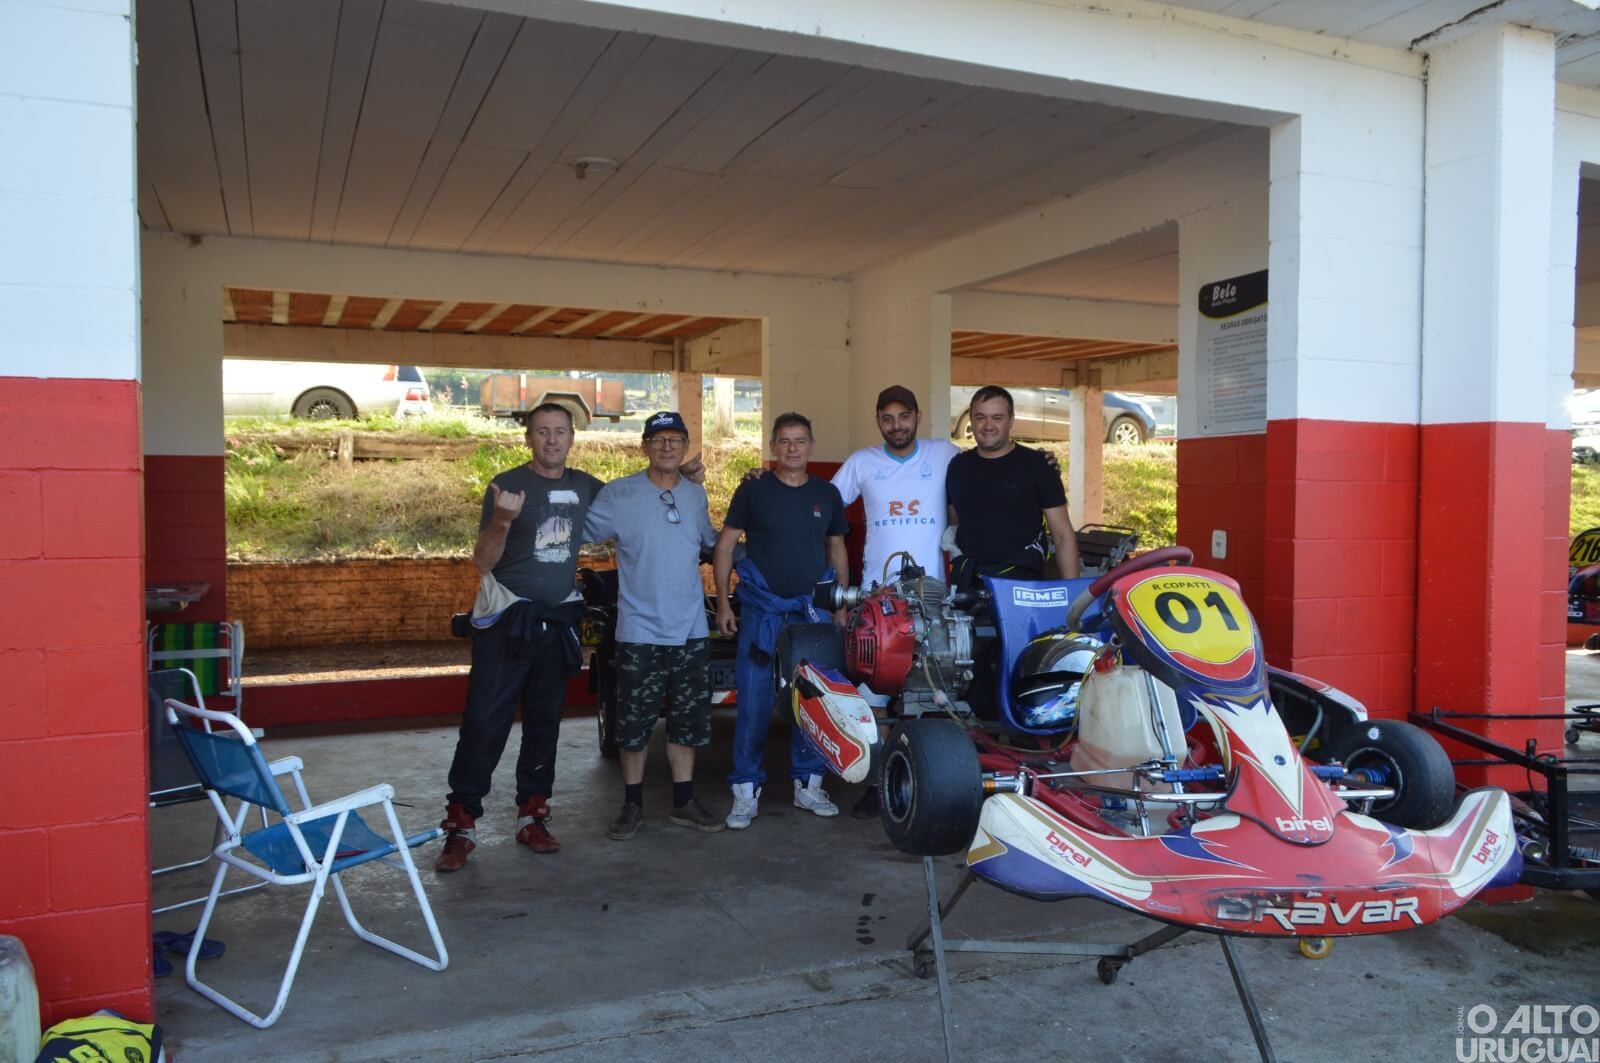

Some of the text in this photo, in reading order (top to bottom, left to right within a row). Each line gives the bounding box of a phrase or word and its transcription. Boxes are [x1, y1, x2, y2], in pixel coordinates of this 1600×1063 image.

[1212, 283, 1237, 301] Belo
[889, 499, 920, 517] RS
[1016, 590, 1065, 600] IAME
[1155, 591, 1240, 633] 01
[1275, 816, 1332, 832] birel
[1046, 831, 1092, 867] birel
[1472, 829, 1498, 864] birel
